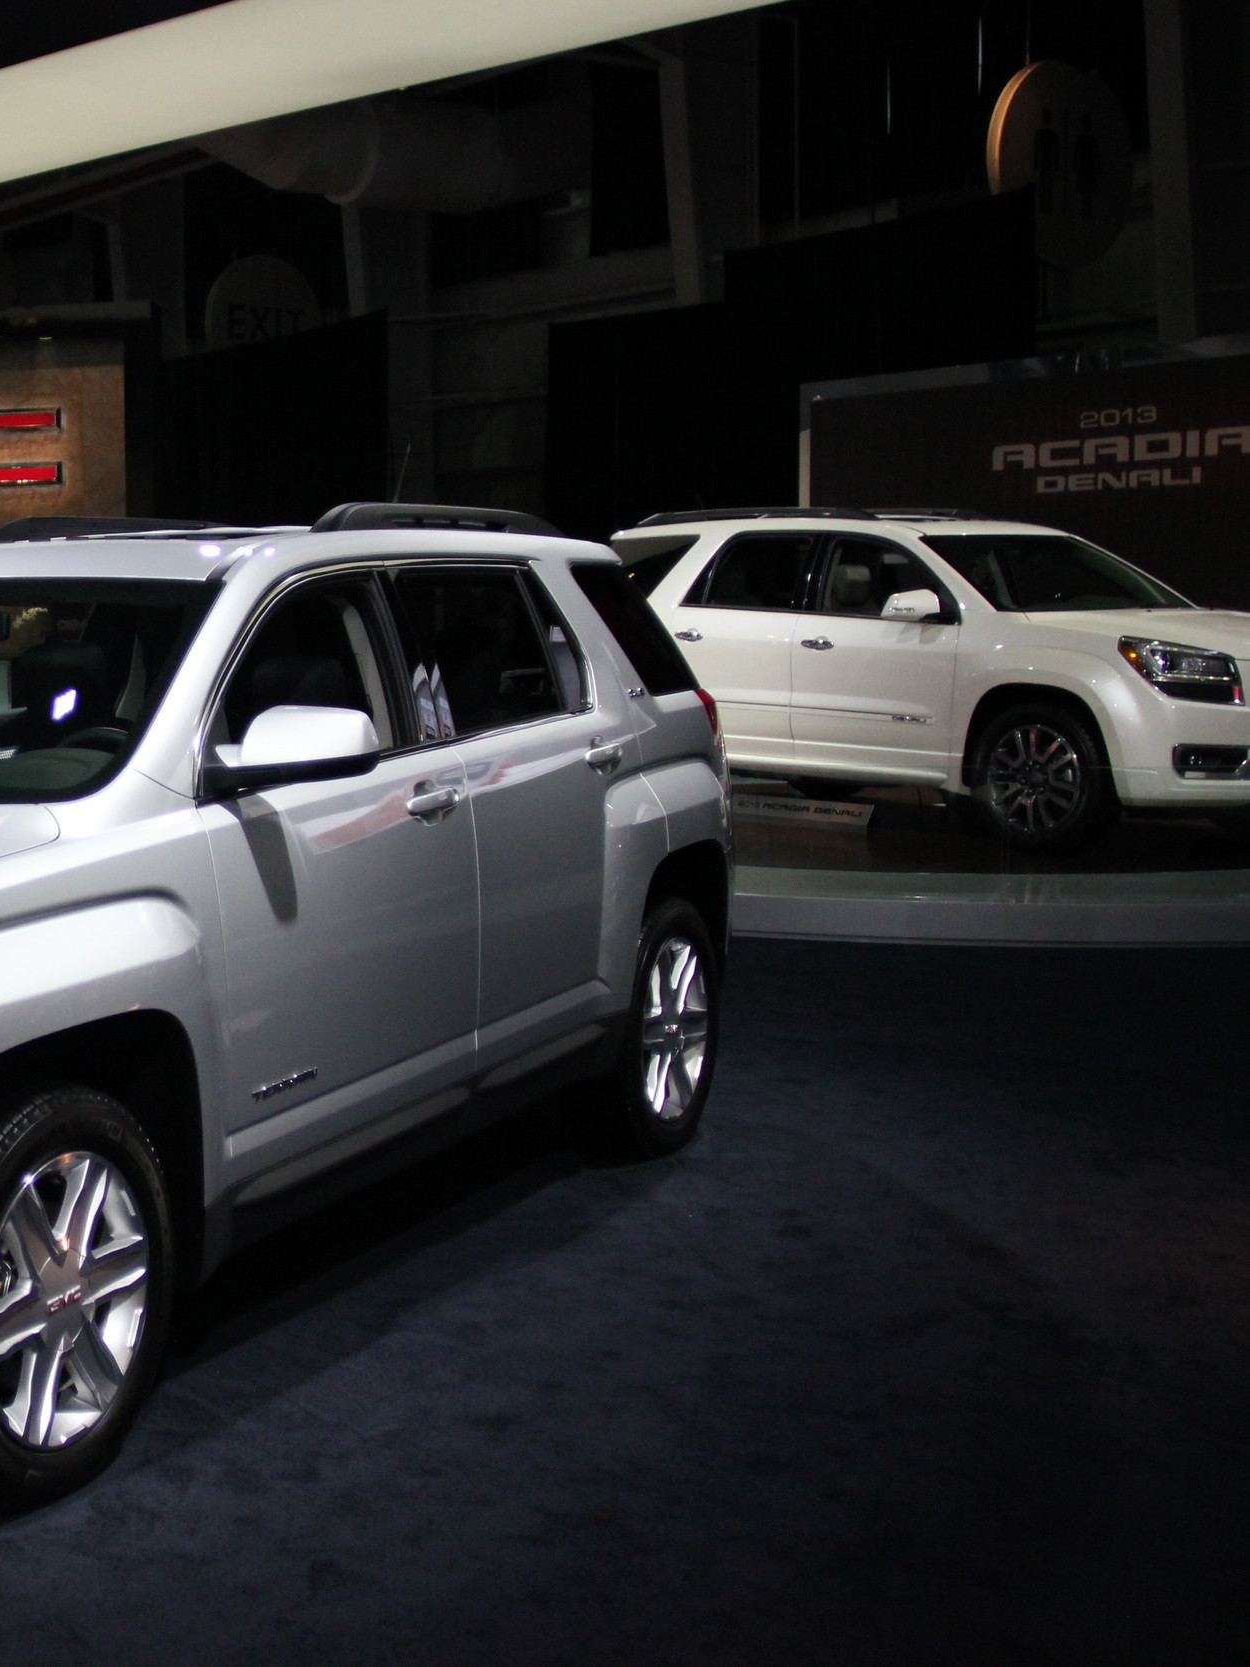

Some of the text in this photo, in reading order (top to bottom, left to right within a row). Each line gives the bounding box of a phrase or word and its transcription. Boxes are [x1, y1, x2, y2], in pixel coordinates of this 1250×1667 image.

[228, 304, 306, 340] EXIT
[1079, 405, 1157, 429] 2013
[991, 425, 1250, 471] ACADIA
[1036, 466, 1202, 494] DENALI
[46, 1285, 82, 1314] GMC
